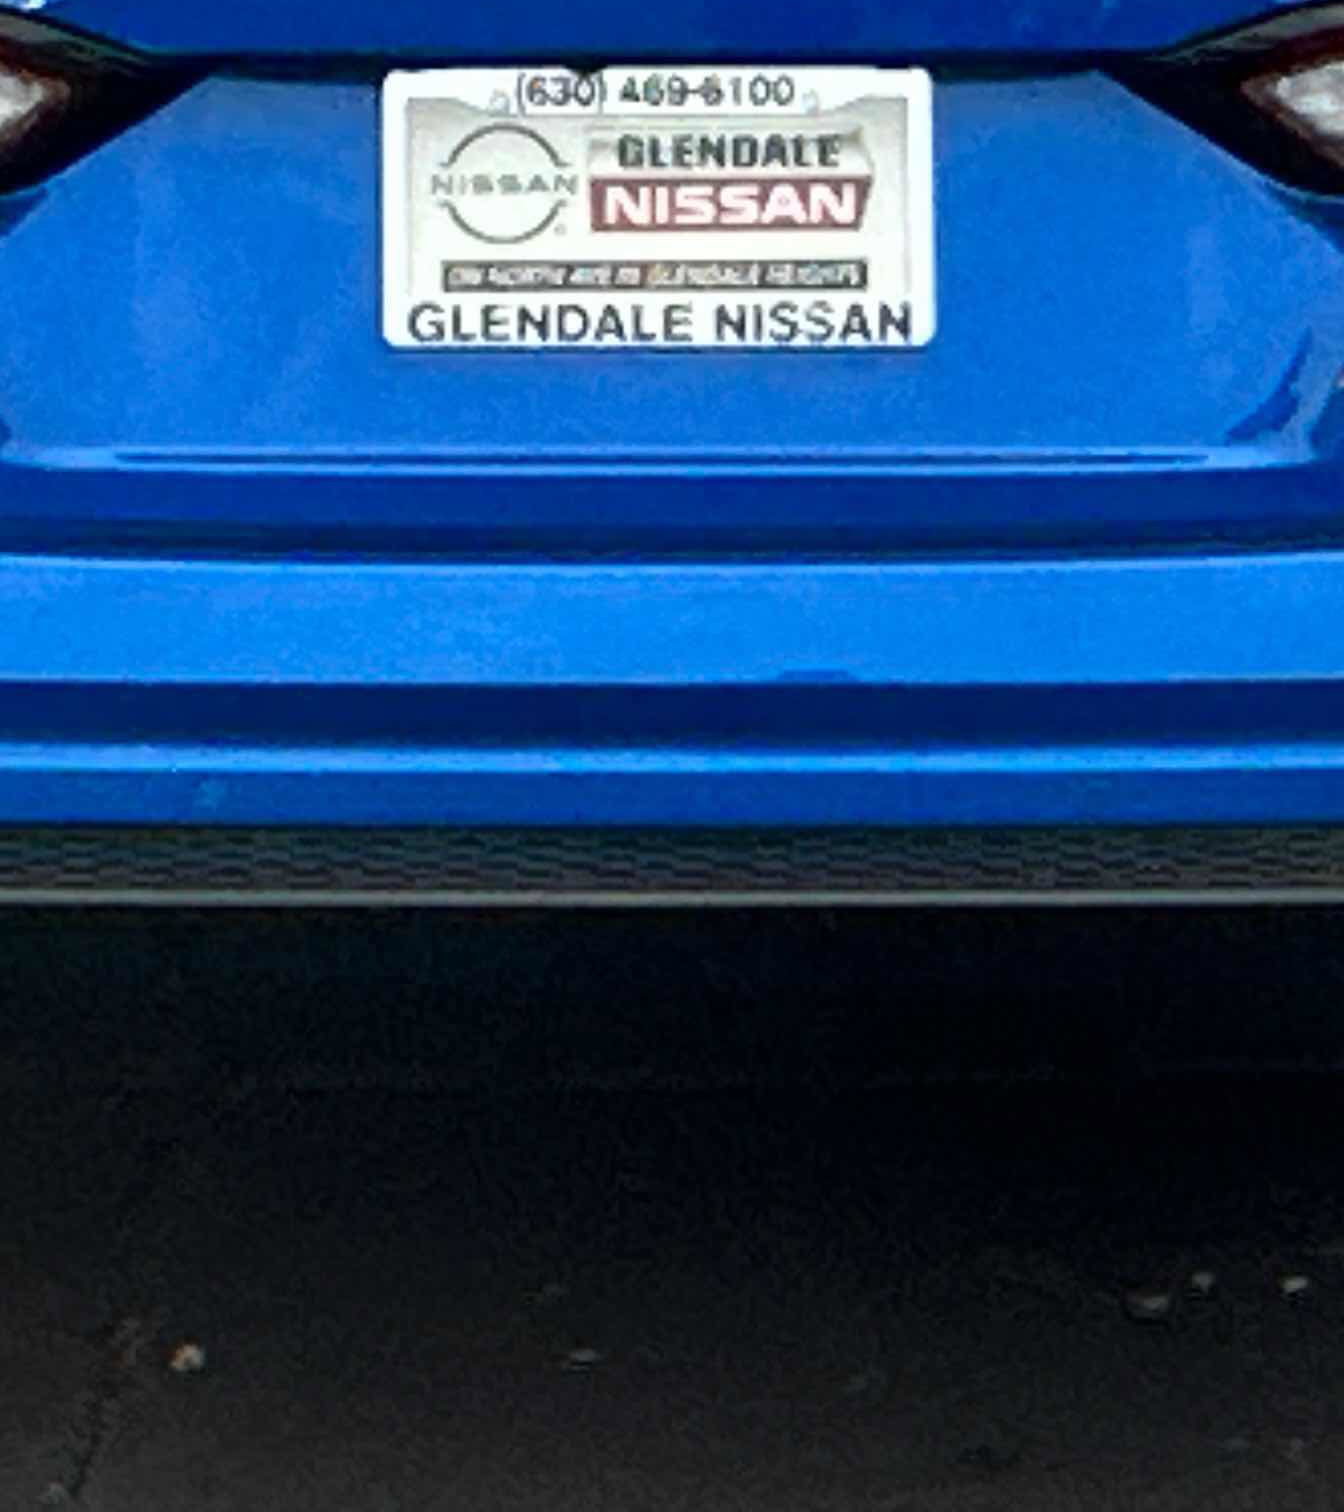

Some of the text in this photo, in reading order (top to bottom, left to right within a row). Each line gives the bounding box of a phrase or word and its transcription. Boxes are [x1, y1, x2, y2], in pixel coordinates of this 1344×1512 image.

[516, 72, 605, 114] (630)
[618, 133, 840, 168] GLENDALE
[431, 174, 578, 194] NISSAN
[605, 183, 856, 225] NISSAN
[406, 301, 913, 343] GLENDALE NISSAN
